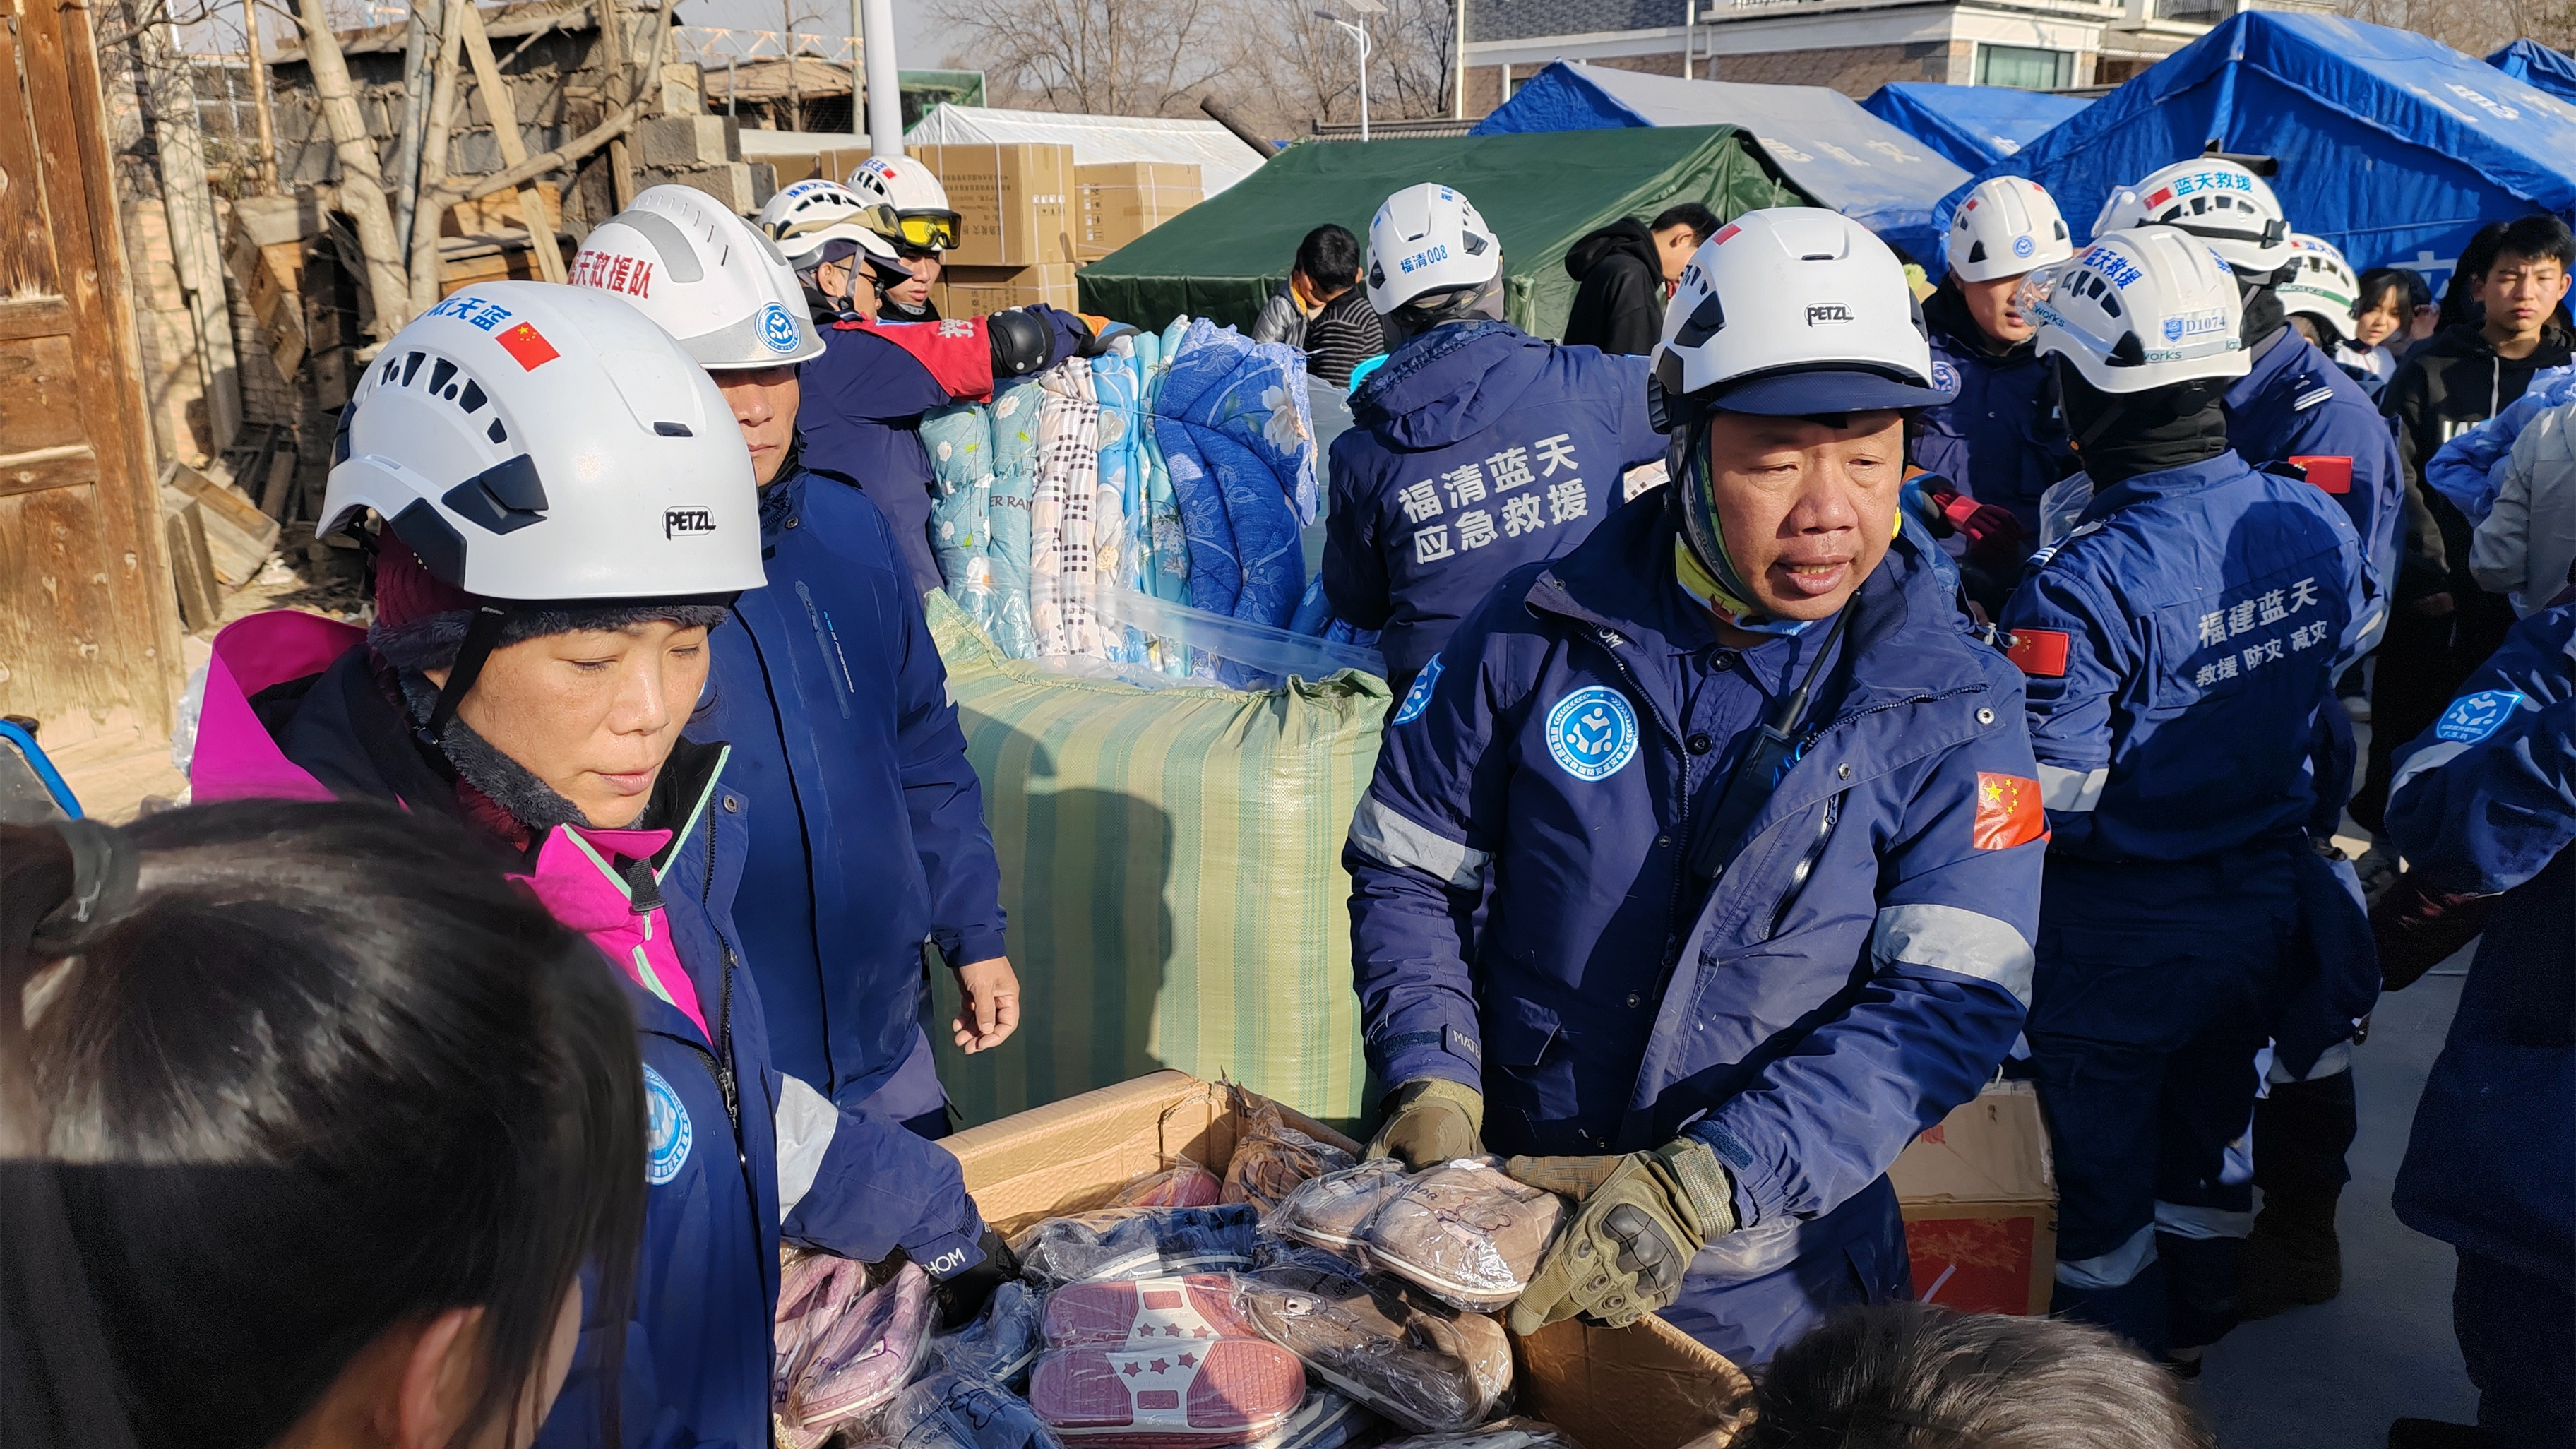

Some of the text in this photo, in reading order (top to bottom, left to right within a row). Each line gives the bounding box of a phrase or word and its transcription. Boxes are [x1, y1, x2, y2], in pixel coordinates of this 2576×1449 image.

[2174, 172, 2252, 196] 蓝天救援
[2083, 247, 2143, 290] 蓝天救援
[1808, 306, 1855, 327] PETZL
[2186, 316, 2226, 332] D1074
[1398, 433, 1579, 524] 福清蓝天
[666, 511, 717, 541] PETZL
[1414, 477, 1589, 564] 应急救援
[2198, 576, 2318, 649] 福建蓝天
[2195, 620, 2327, 688] 救援 防灾 减灾
